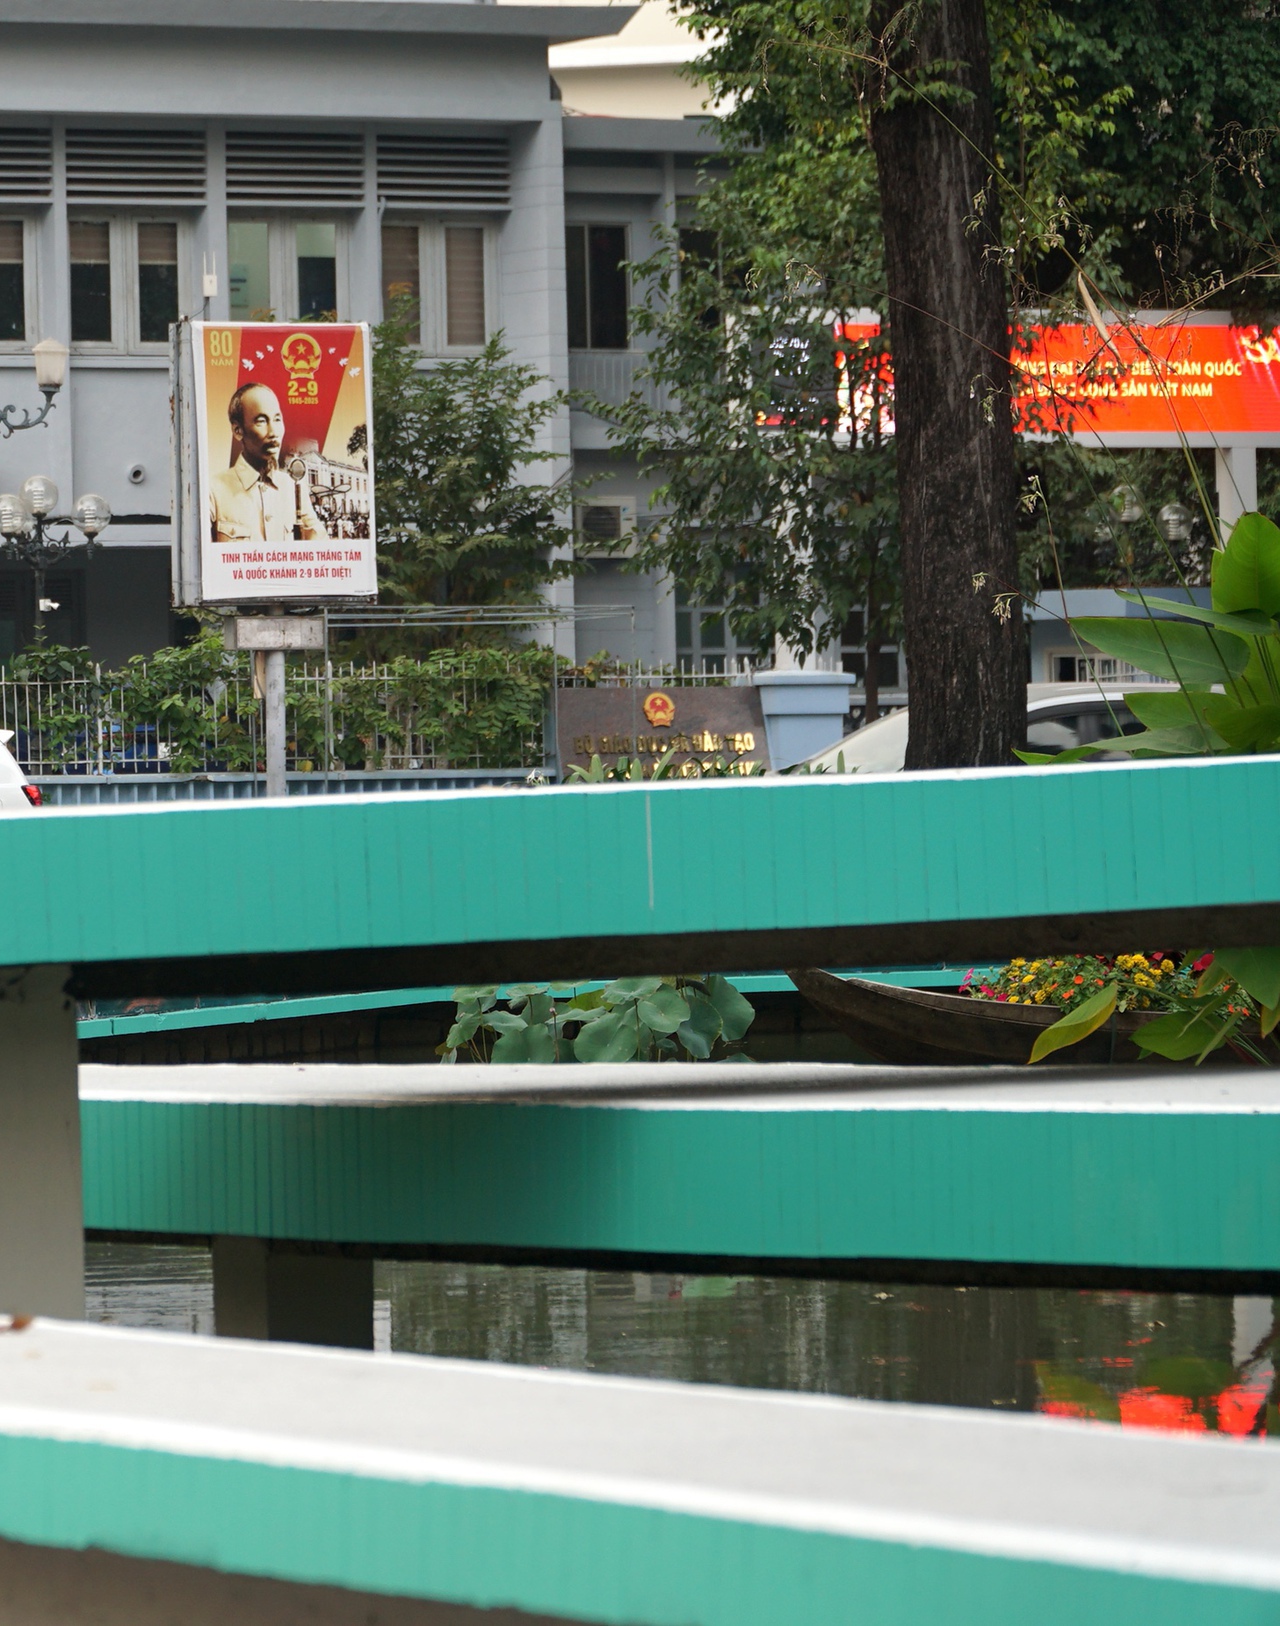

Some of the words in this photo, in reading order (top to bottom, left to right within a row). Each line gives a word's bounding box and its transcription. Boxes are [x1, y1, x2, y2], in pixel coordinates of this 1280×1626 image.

[210, 330, 233, 357] 80
[1204, 357, 1242, 378] QUỐC
[288, 380, 318, 396] 2-9
[1121, 377, 1148, 397] SẢN
[1182, 381, 1213, 397] NAM
[288, 396, 318, 405] 1945-2025
[222, 553, 240, 563] TINH
[266, 550, 288, 562] CÁCH
[290, 551, 314, 563] MẠNG
[316, 549, 342, 561] THÁNG
[345, 549, 361, 561] TÁM
[233, 568, 243, 580] VÀ
[246, 566, 267, 580] QUỐC
[270, 567, 297, 579] KHÁNH
[314, 565, 329, 578] BẤT
[725, 732, 755, 755] TẠO
